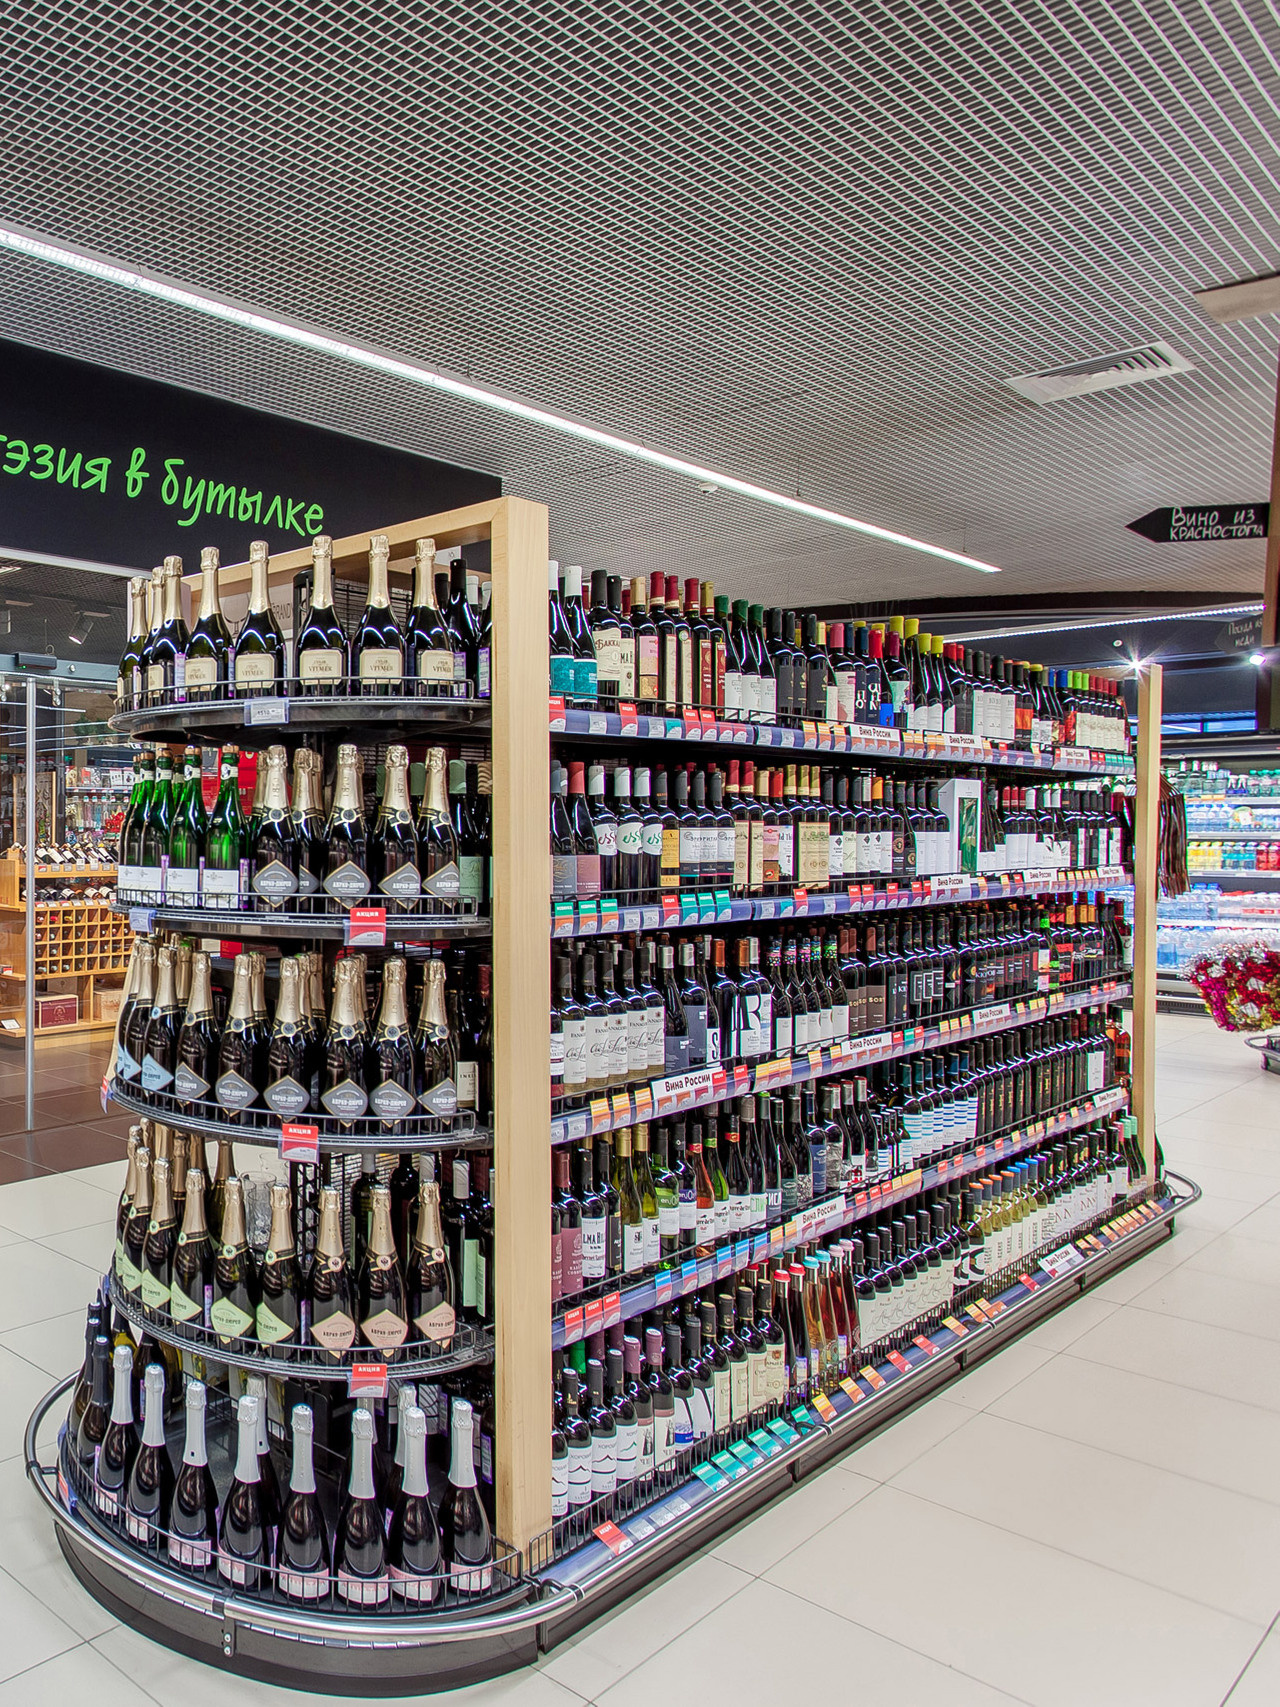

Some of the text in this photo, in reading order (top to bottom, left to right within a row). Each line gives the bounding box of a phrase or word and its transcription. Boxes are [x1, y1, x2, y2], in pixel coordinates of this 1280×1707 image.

[125, 447, 149, 498] в
[161, 458, 324, 537] бутылке
[1171, 507, 1219, 526] Вино
[665, 1074, 710, 1092] Вина России
[289, 1127, 312, 1135] АКЦИЯ
[802, 1203, 837, 1223] Вина России
